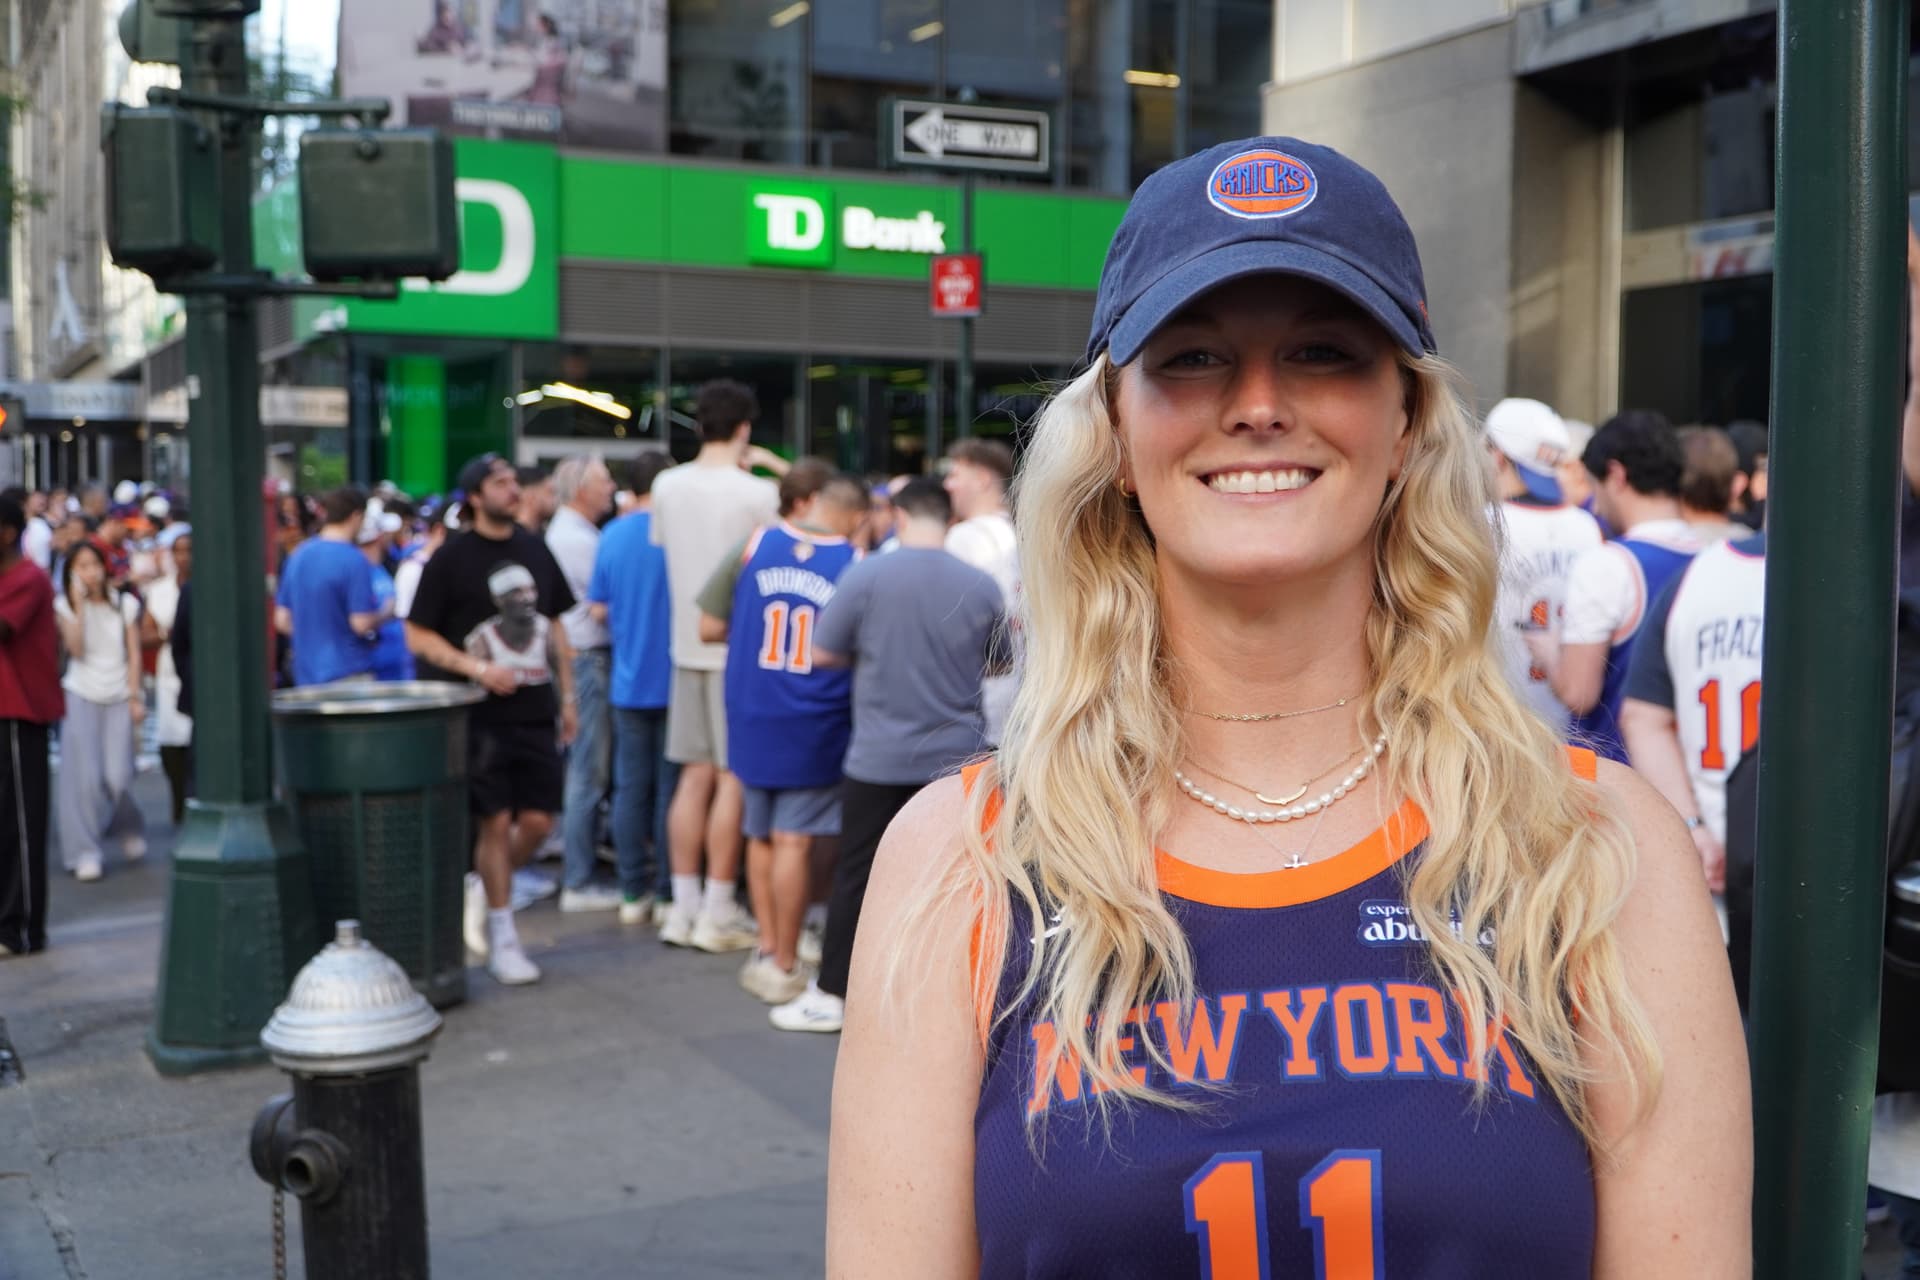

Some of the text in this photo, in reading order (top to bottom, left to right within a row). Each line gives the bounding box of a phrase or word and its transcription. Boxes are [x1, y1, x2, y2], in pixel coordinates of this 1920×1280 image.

[926, 122, 1026, 148] ONE WAY
[1220, 160, 1304, 194] KNICKS
[401, 177, 537, 296] D
[753, 193, 946, 254] TD Bank
[758, 600, 815, 675] 11
[1697, 615, 1762, 670] FRAZ
[1183, 1148, 1385, 1280] 11
